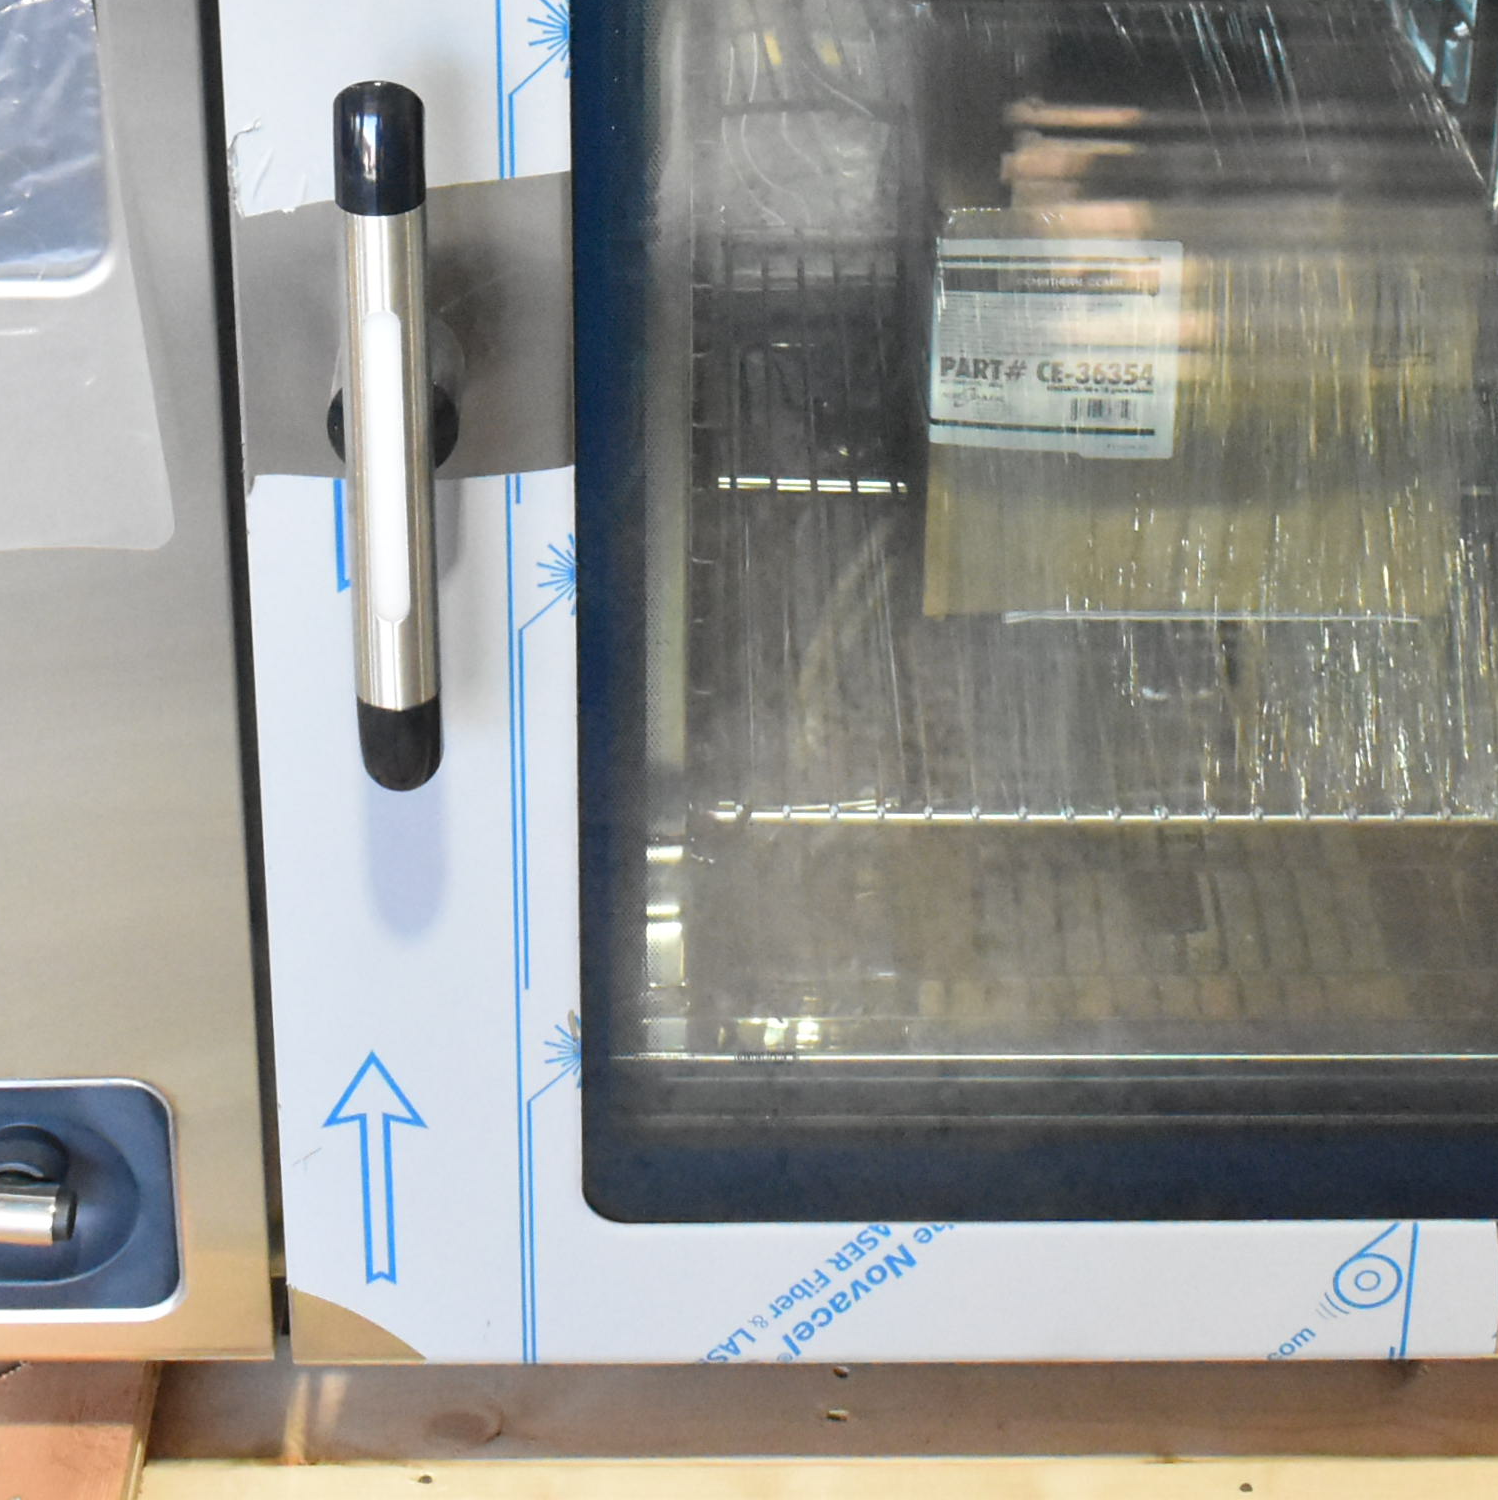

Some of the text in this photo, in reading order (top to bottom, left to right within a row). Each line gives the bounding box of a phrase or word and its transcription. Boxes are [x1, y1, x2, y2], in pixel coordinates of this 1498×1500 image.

[940, 356, 1155, 386] PART# CE-36354
[749, 1268, 831, 1328] Fiber &
